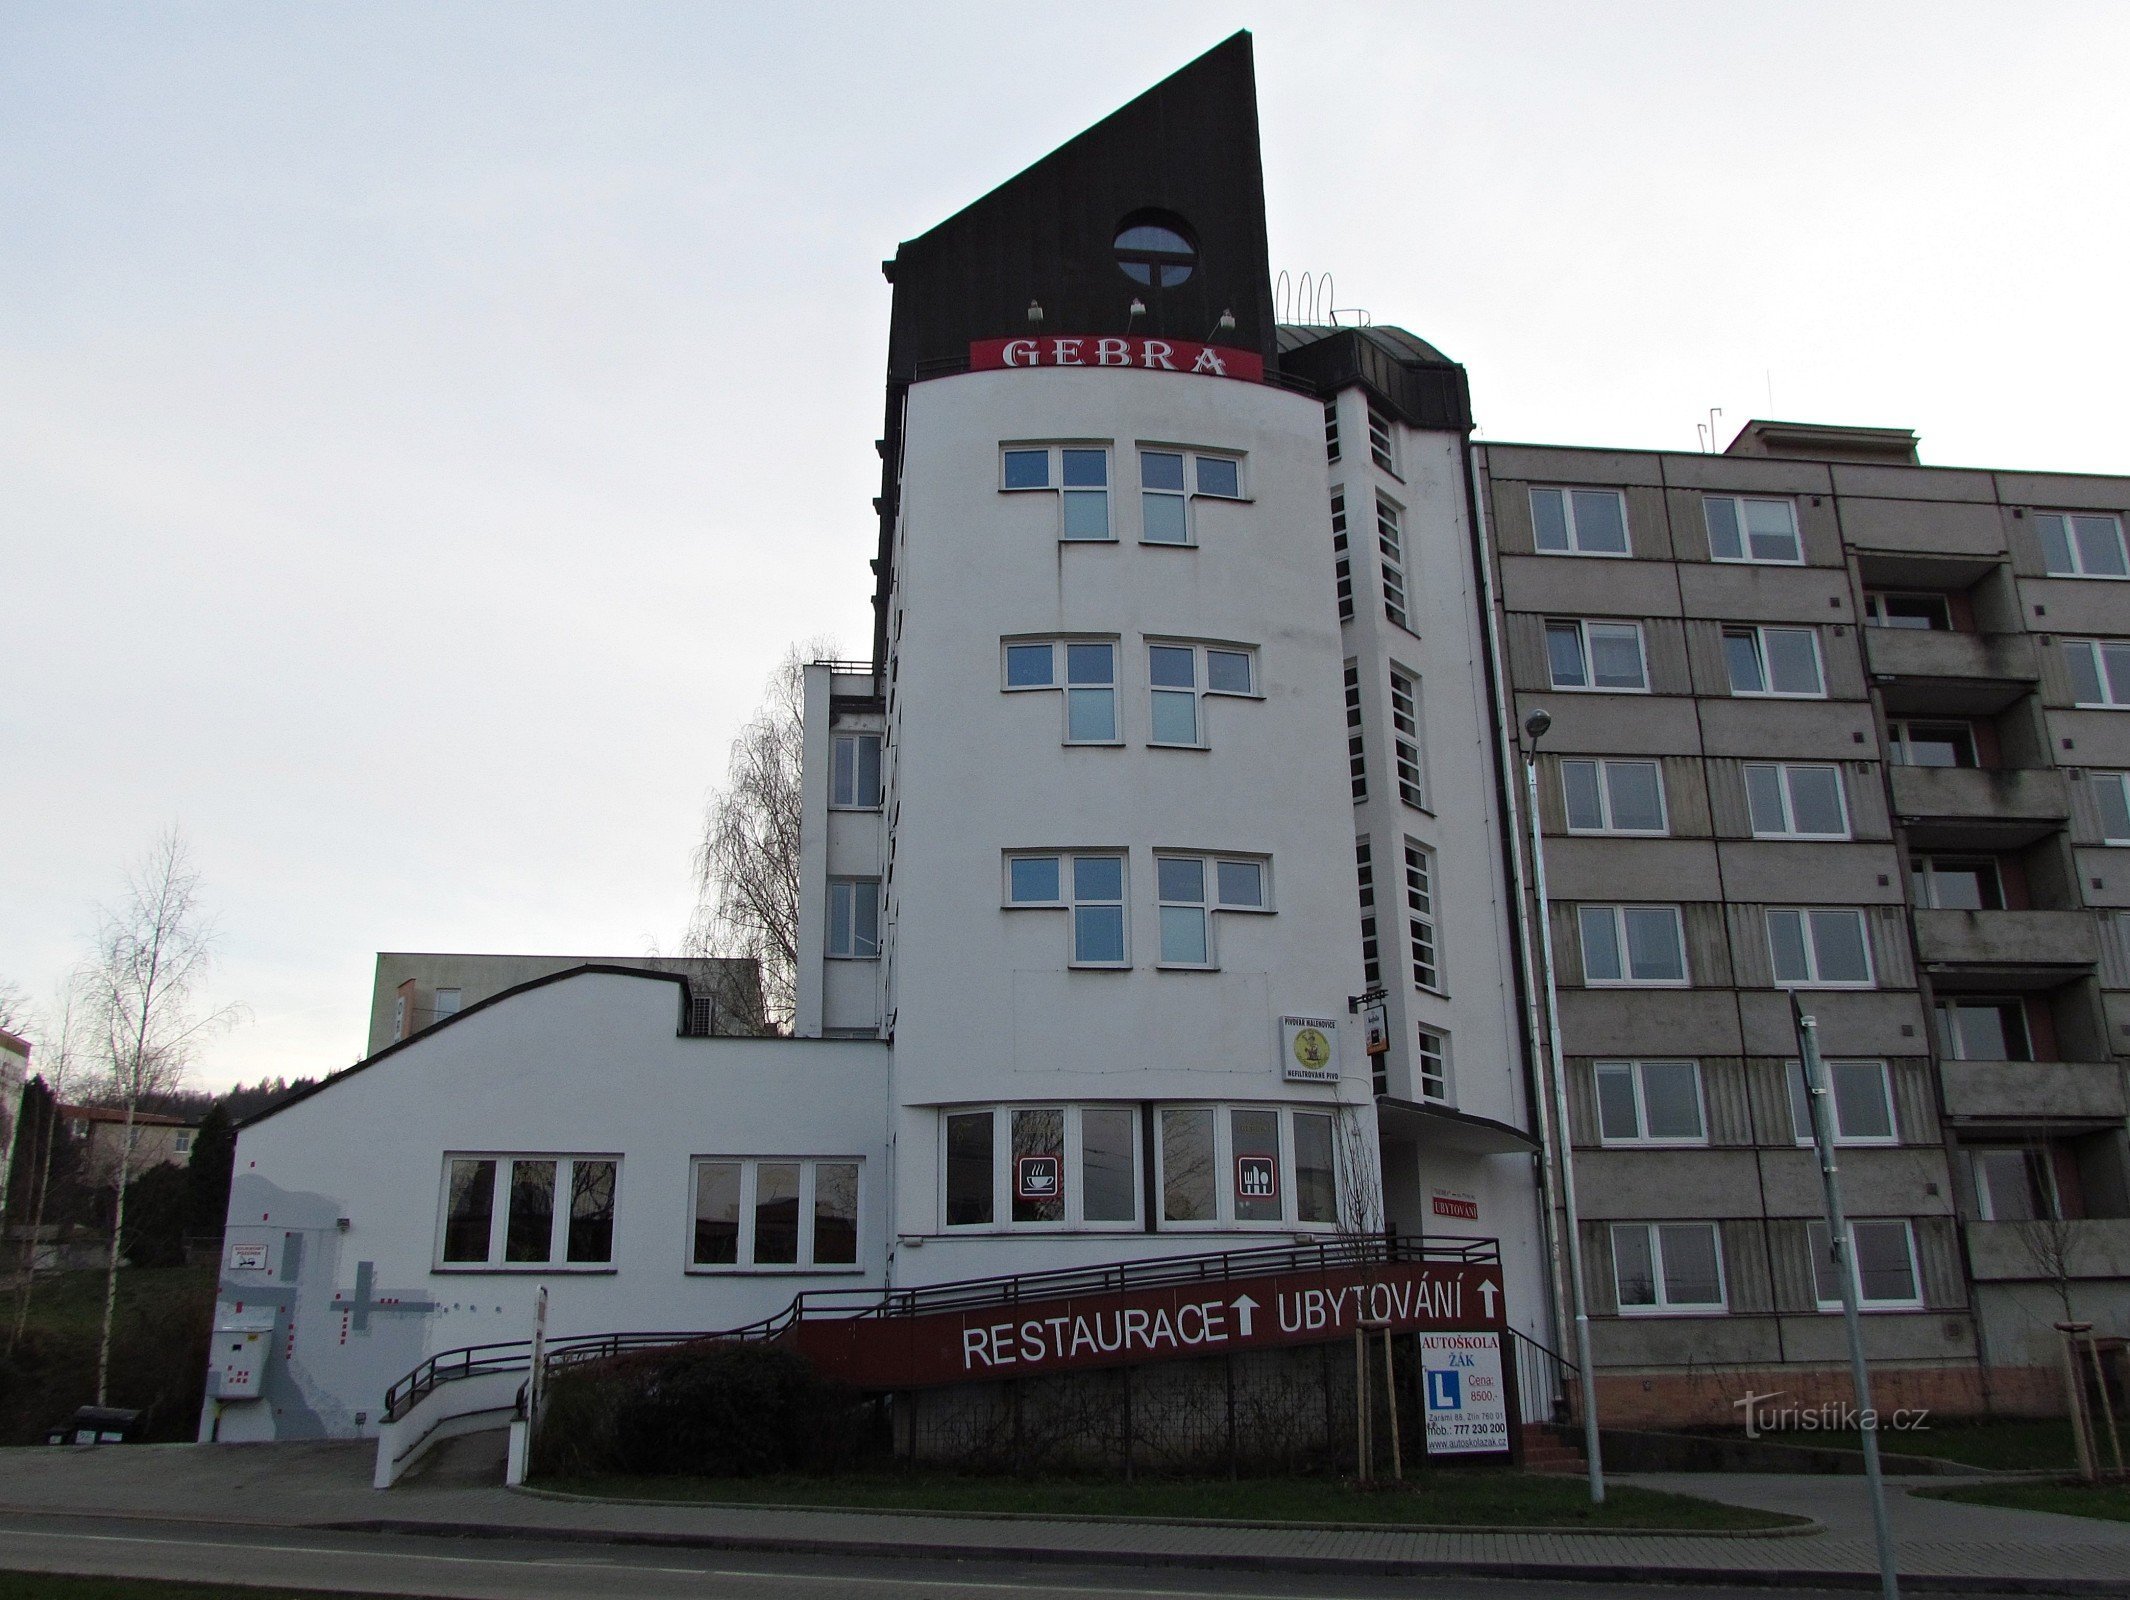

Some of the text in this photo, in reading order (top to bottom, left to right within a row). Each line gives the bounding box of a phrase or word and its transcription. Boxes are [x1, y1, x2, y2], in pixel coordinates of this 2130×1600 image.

[1002, 338, 1227, 376] GEBRA
[1434, 1201, 1477, 1218] UBYTOVÁNÍ
[962, 1270, 1464, 1369] RESTAURACE UBYTOVÁNÍ
[1422, 1334, 1498, 1349] AUTOŠKOLA
[1449, 1352, 1474, 1367] ŽÁK
[1468, 1374, 1494, 1386] Cena:
[1427, 1422, 1506, 1436] mob.: 777 230 200
[1428, 1437, 1506, 1448] www.autoskolazak.cz
